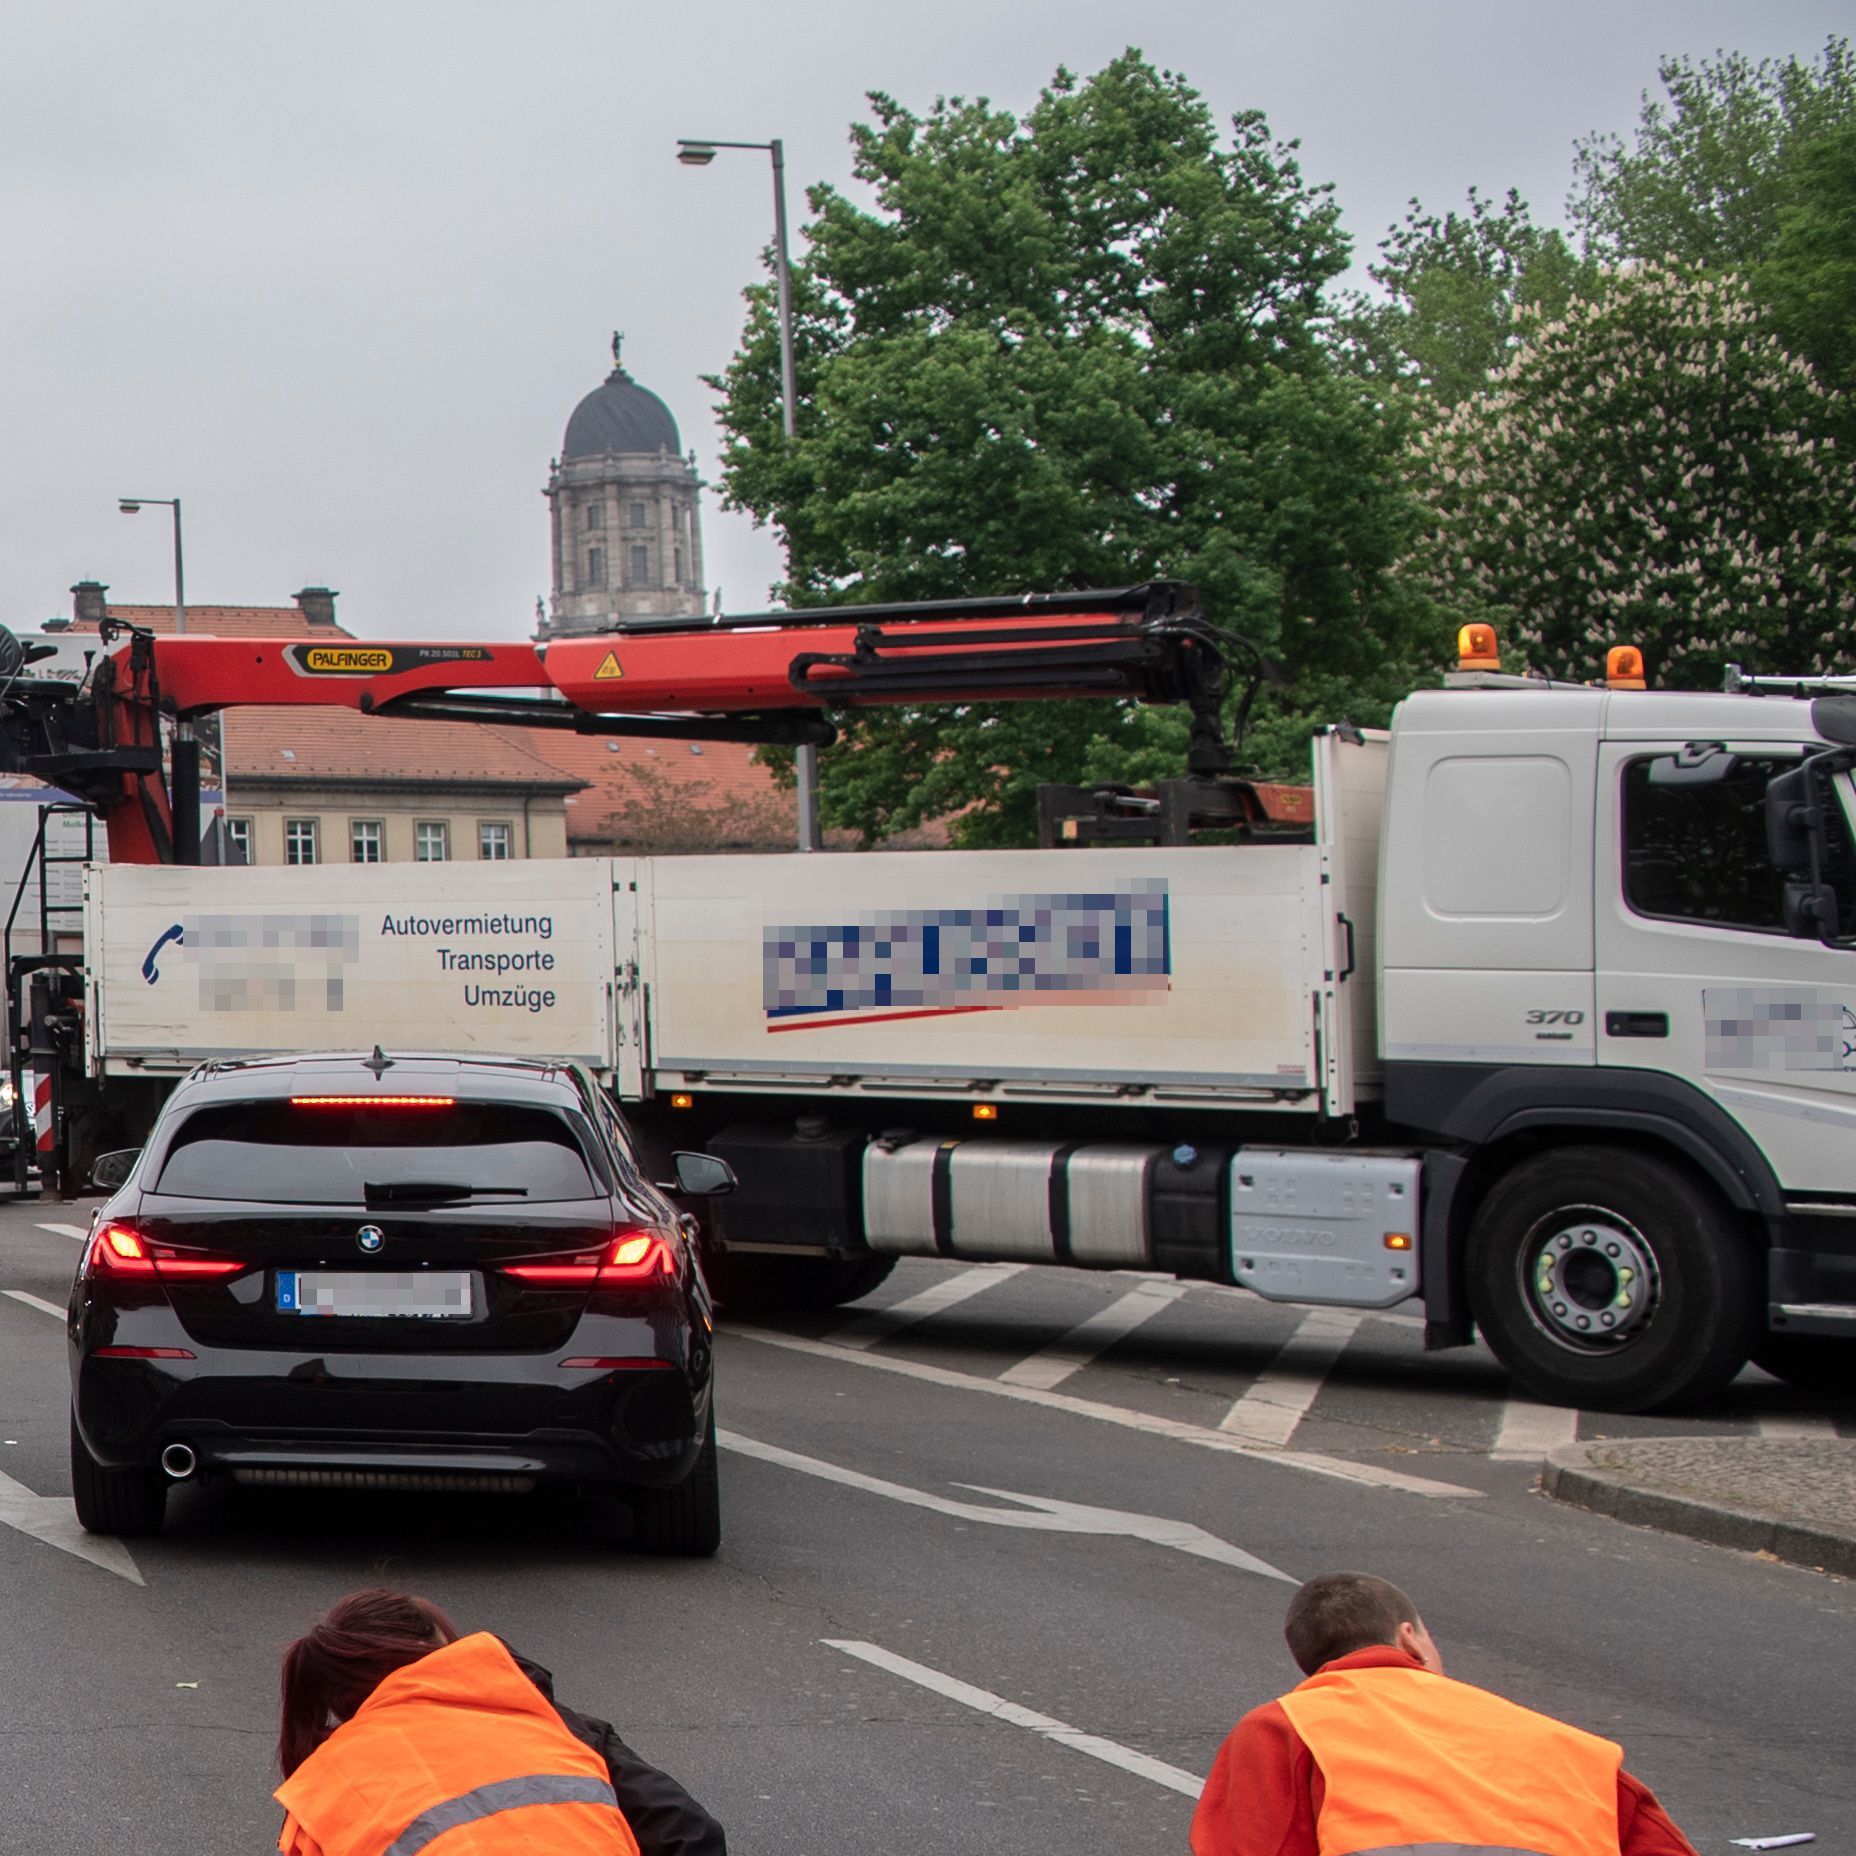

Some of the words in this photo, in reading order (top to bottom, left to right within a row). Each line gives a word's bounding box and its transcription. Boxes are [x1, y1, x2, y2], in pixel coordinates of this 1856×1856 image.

[312, 652, 388, 667] PALFINGER
[381, 913, 553, 939] Autovermietung
[436, 949, 555, 976] Transporte
[464, 984, 556, 1013] Umzüge
[1525, 1009, 1585, 1025] 370
[1241, 1226, 1336, 1247] VOLVO
